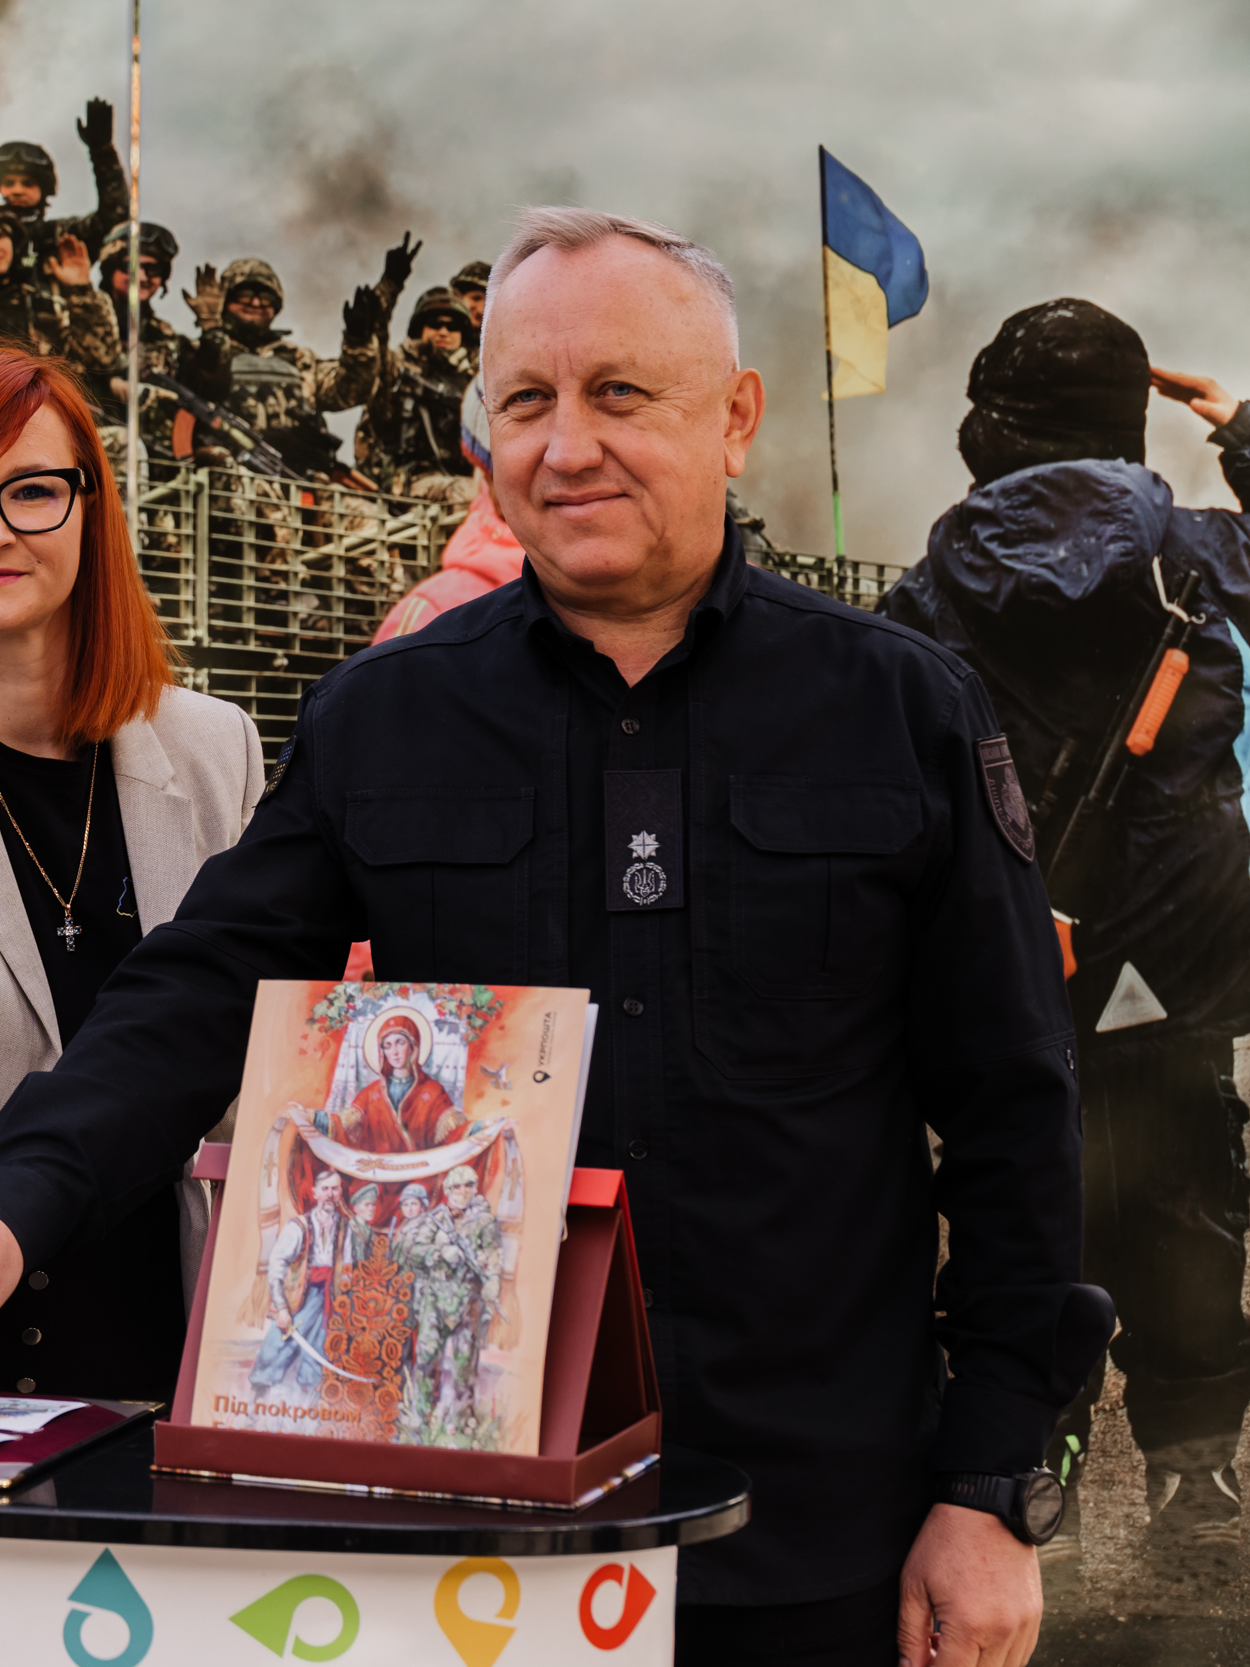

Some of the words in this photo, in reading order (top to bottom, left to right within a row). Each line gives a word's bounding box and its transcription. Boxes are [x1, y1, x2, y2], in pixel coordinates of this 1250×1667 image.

[537, 1011, 552, 1068] УКРПОШТА
[213, 1394, 248, 1416] Під
[254, 1401, 361, 1423] покровом
